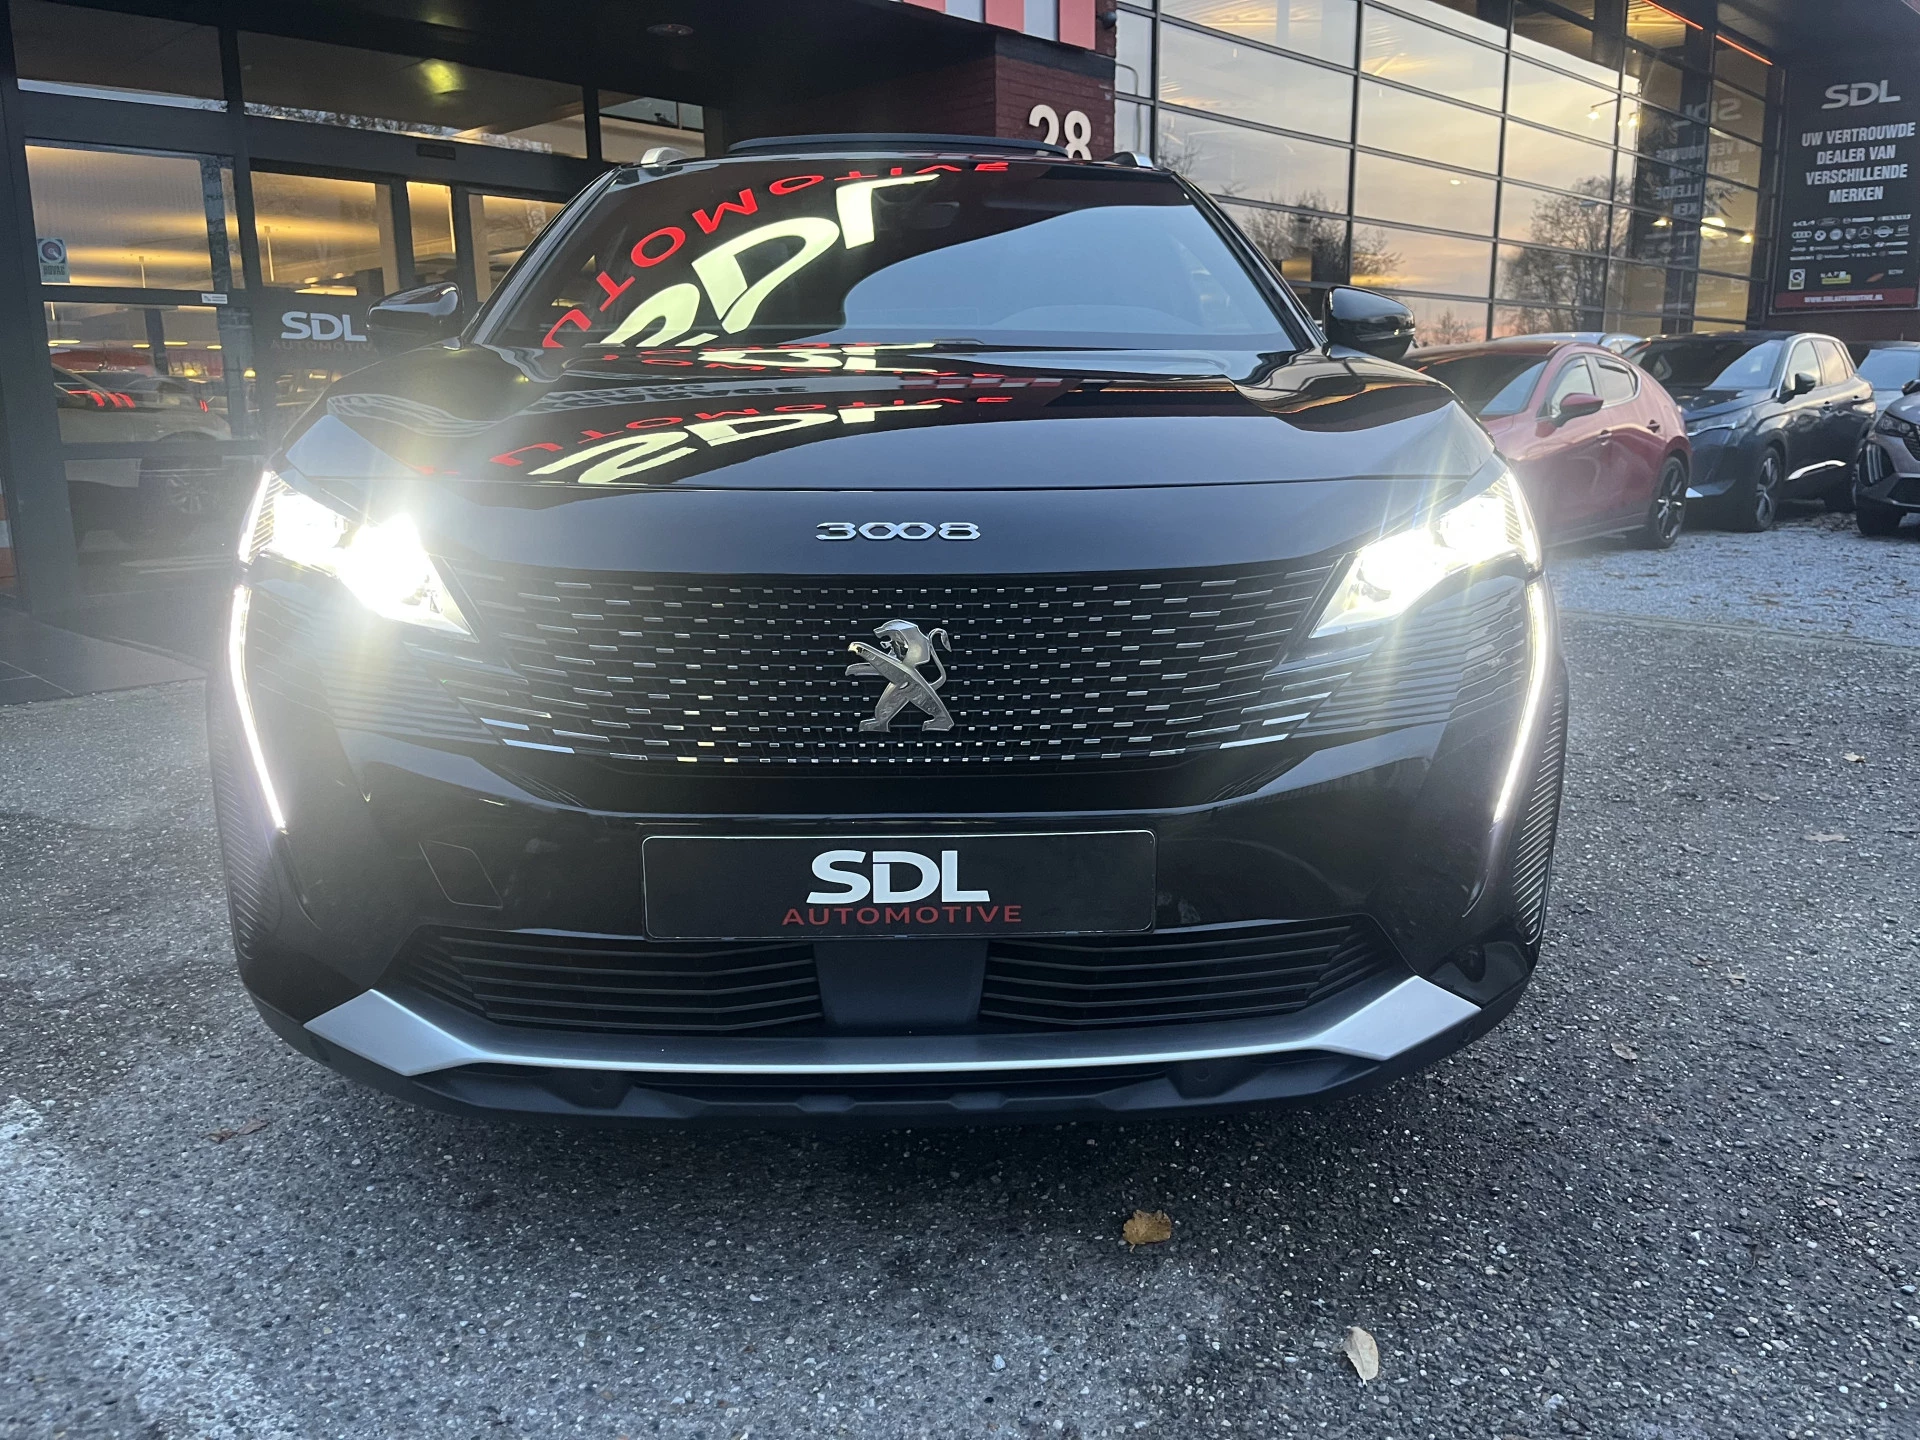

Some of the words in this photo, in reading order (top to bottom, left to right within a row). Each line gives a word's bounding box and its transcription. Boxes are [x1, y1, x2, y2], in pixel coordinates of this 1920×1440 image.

[1821, 80, 1901, 109] SDL
[1029, 104, 1092, 160] 28
[1802, 132, 1823, 147] UW
[1826, 122, 1916, 145] VERTROUWDE
[1816, 147, 1866, 165] DEALER
[1869, 144, 1896, 160] VAN
[1805, 163, 1908, 186] VERSCHILLENDE
[1828, 185, 1884, 204] MERKEN
[281, 311, 367, 342] SDL
[270, 340, 379, 354] AUTOMOTIV
[816, 522, 981, 540] 3008
[806, 850, 990, 904] SDL
[782, 905, 1022, 925] AUTOMOTIVE
